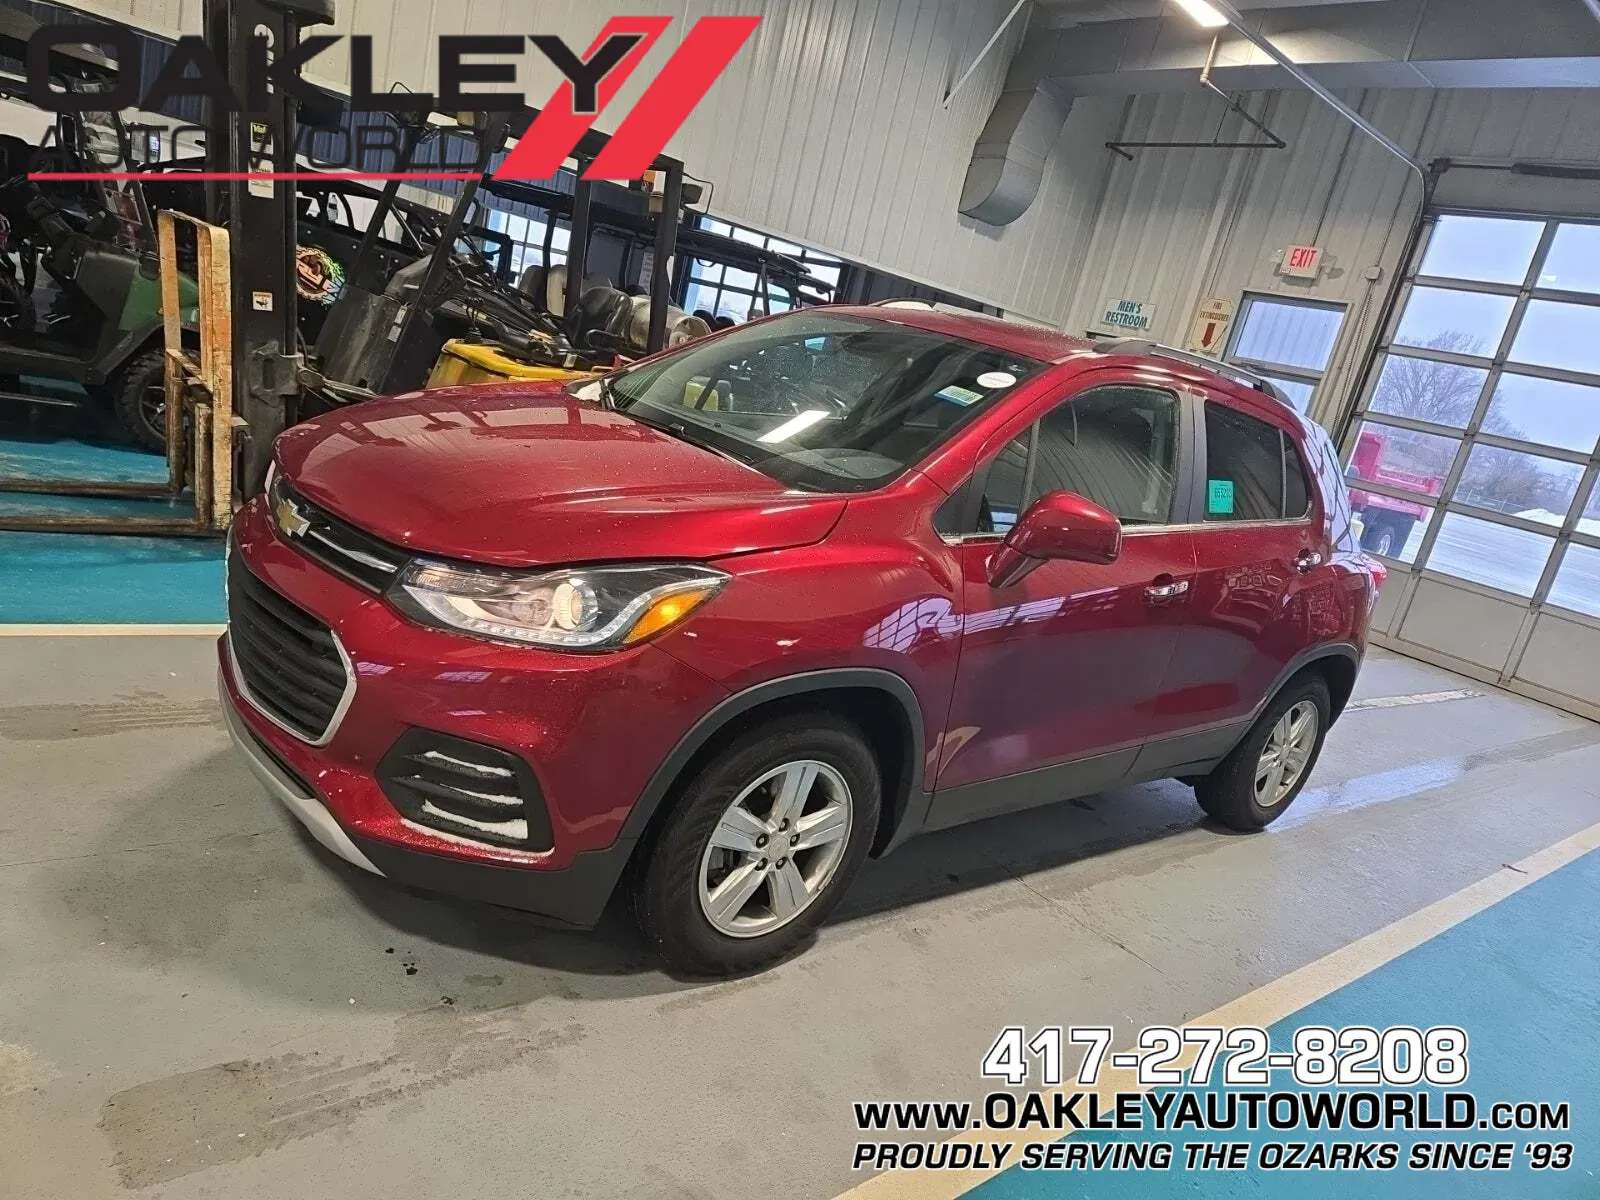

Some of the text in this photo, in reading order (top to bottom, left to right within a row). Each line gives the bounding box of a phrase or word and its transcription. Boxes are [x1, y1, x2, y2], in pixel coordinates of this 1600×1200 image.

[1290, 248, 1317, 268] EXIT
[1117, 300, 1142, 314] MEN'S
[1105, 311, 1148, 328] RESTROOM
